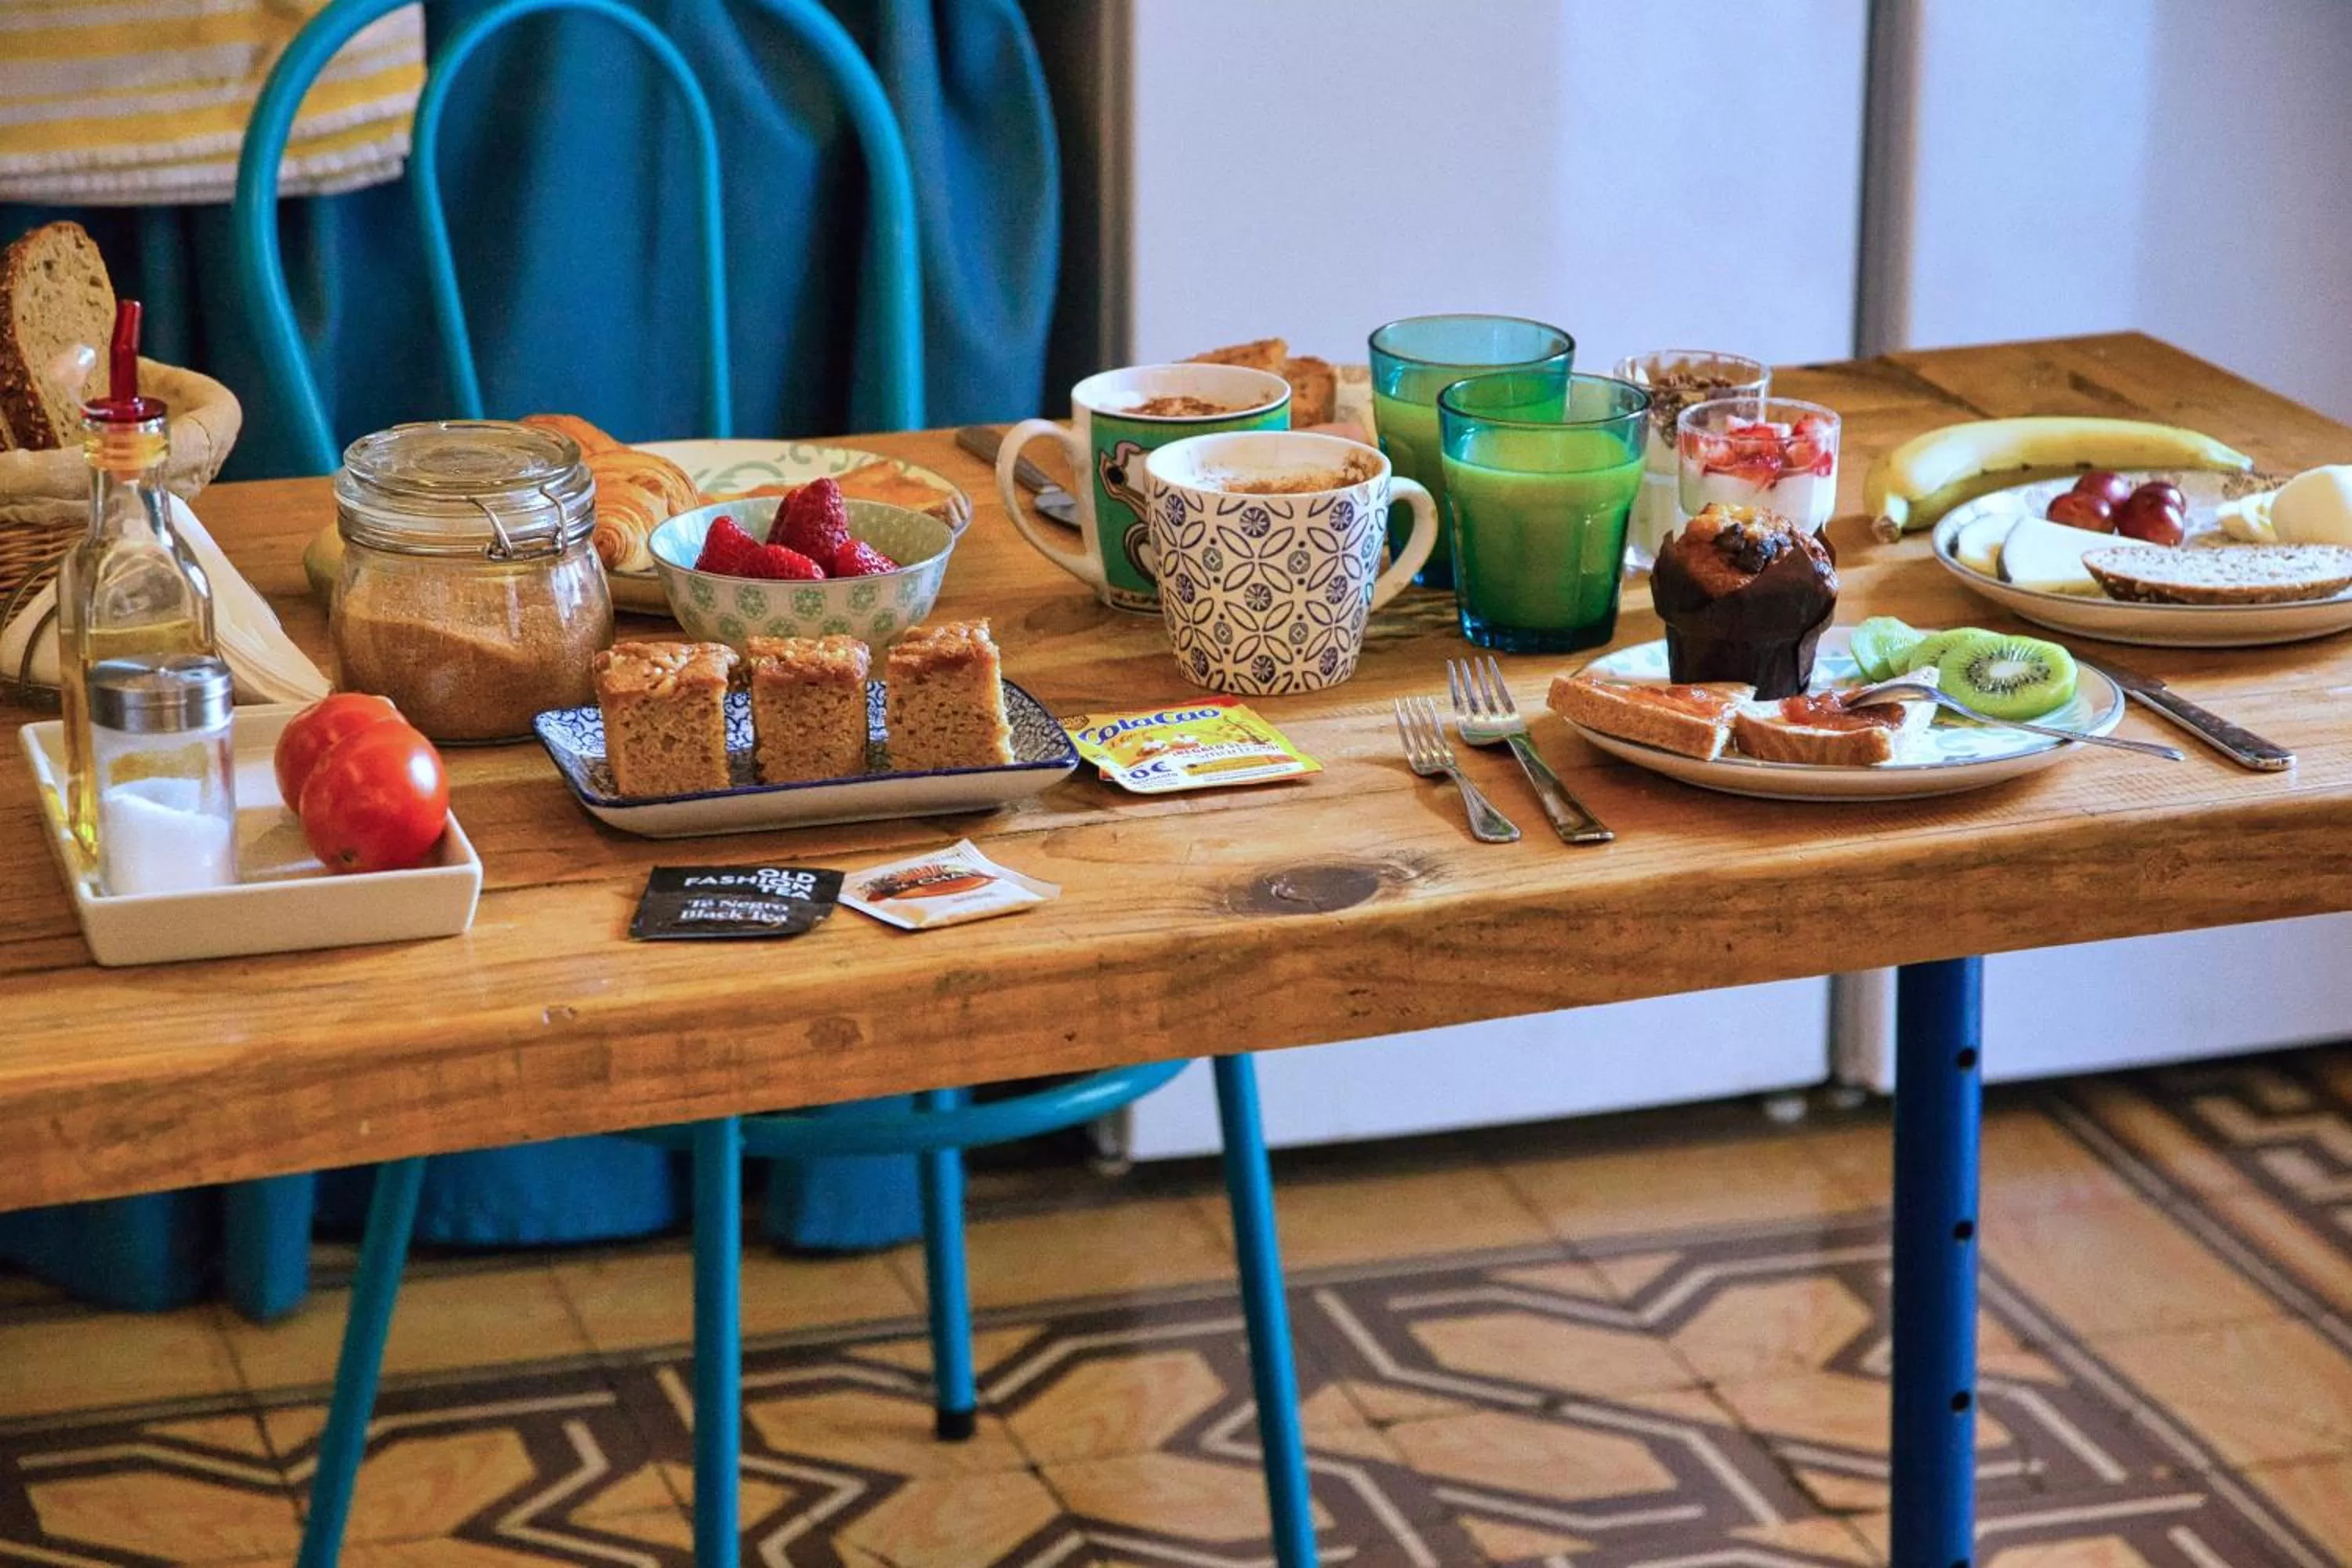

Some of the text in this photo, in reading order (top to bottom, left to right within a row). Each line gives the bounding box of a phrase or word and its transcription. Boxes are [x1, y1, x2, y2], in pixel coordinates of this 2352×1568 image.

[1077, 708, 1221, 745] ColaCao
[757, 868, 817, 884] OLD
[684, 876, 813, 893] FASHION
[757, 884, 811, 901] TEA
[720, 899, 789, 913] Negro
[680, 909, 744, 920] Black
